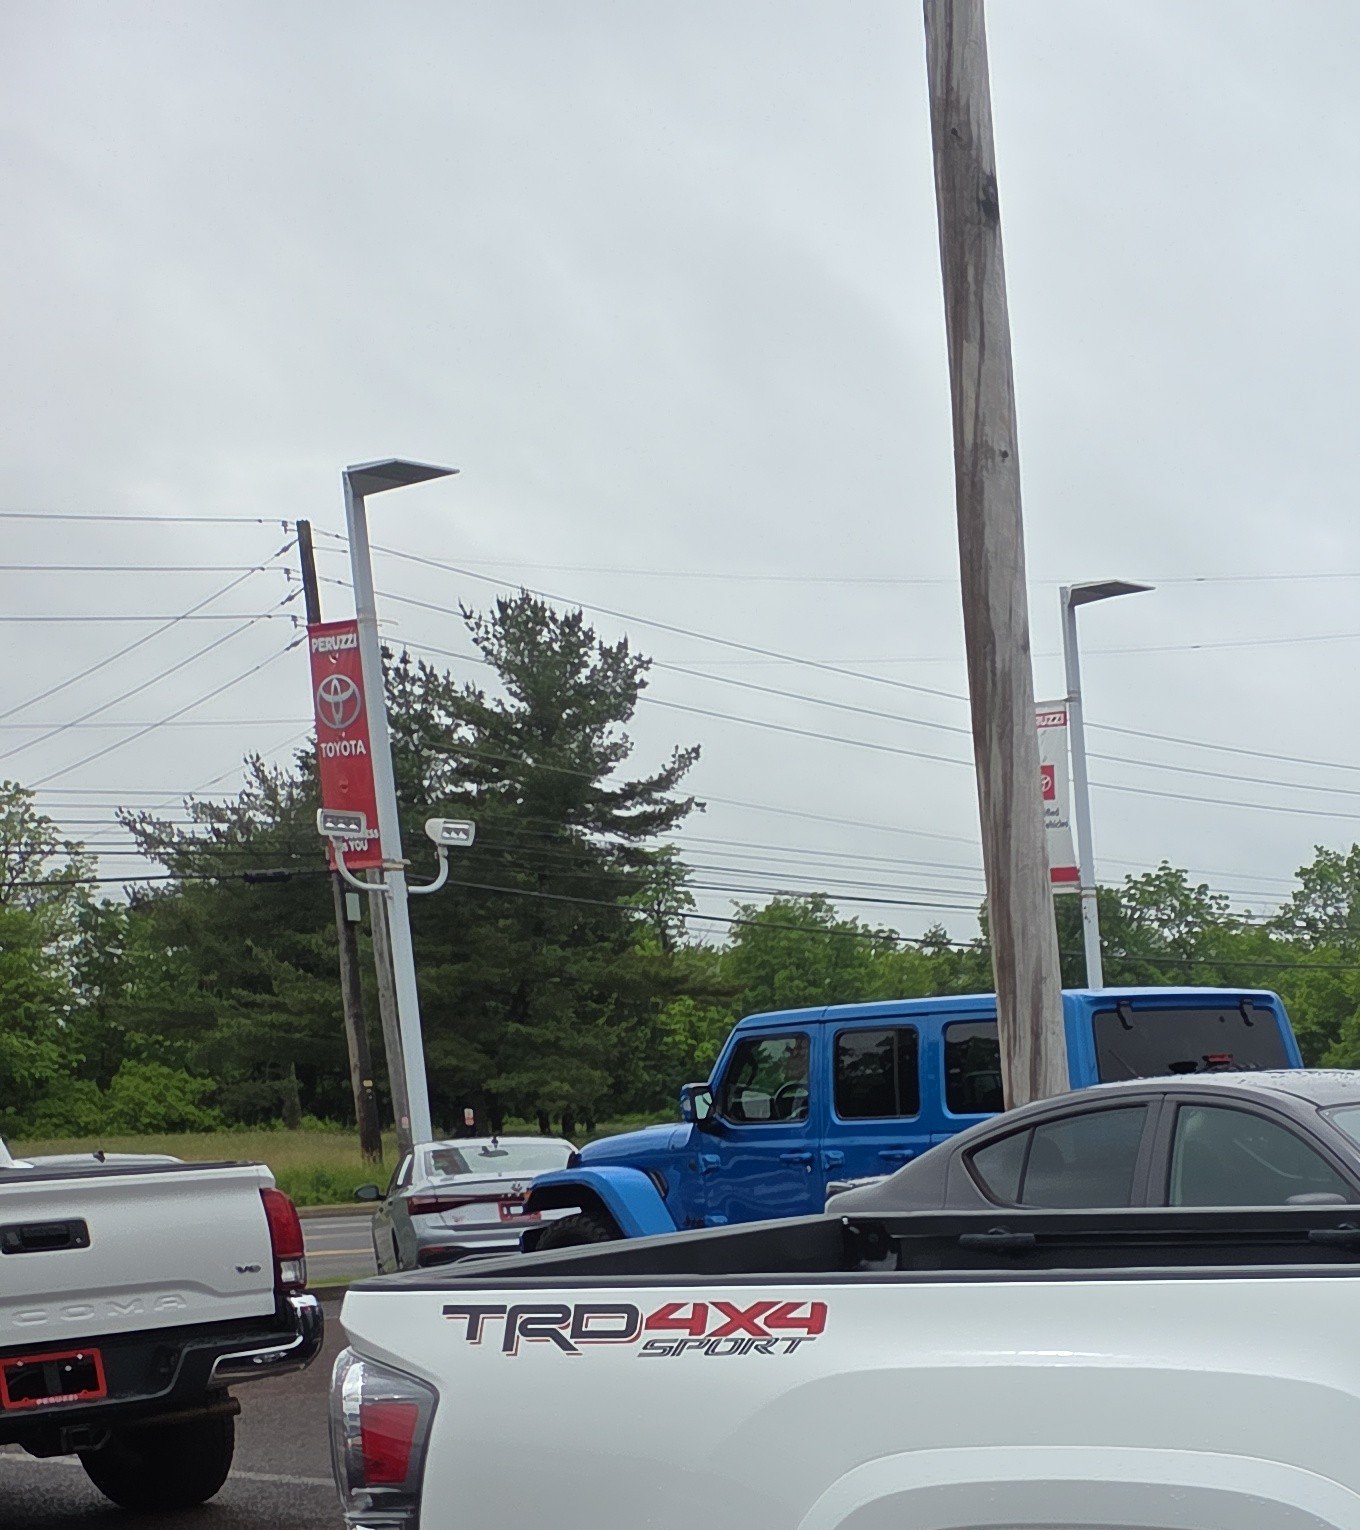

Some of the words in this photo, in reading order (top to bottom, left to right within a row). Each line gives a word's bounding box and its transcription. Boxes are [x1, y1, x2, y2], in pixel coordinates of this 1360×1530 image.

[312, 633, 357, 653] PERUZZI
[1036, 712, 1064, 727] RUZZI
[320, 739, 366, 758] TOYOTA
[12, 1293, 188, 1327] COMA
[442, 1303, 643, 1357] TRD
[637, 1335, 816, 1358] SPORT
